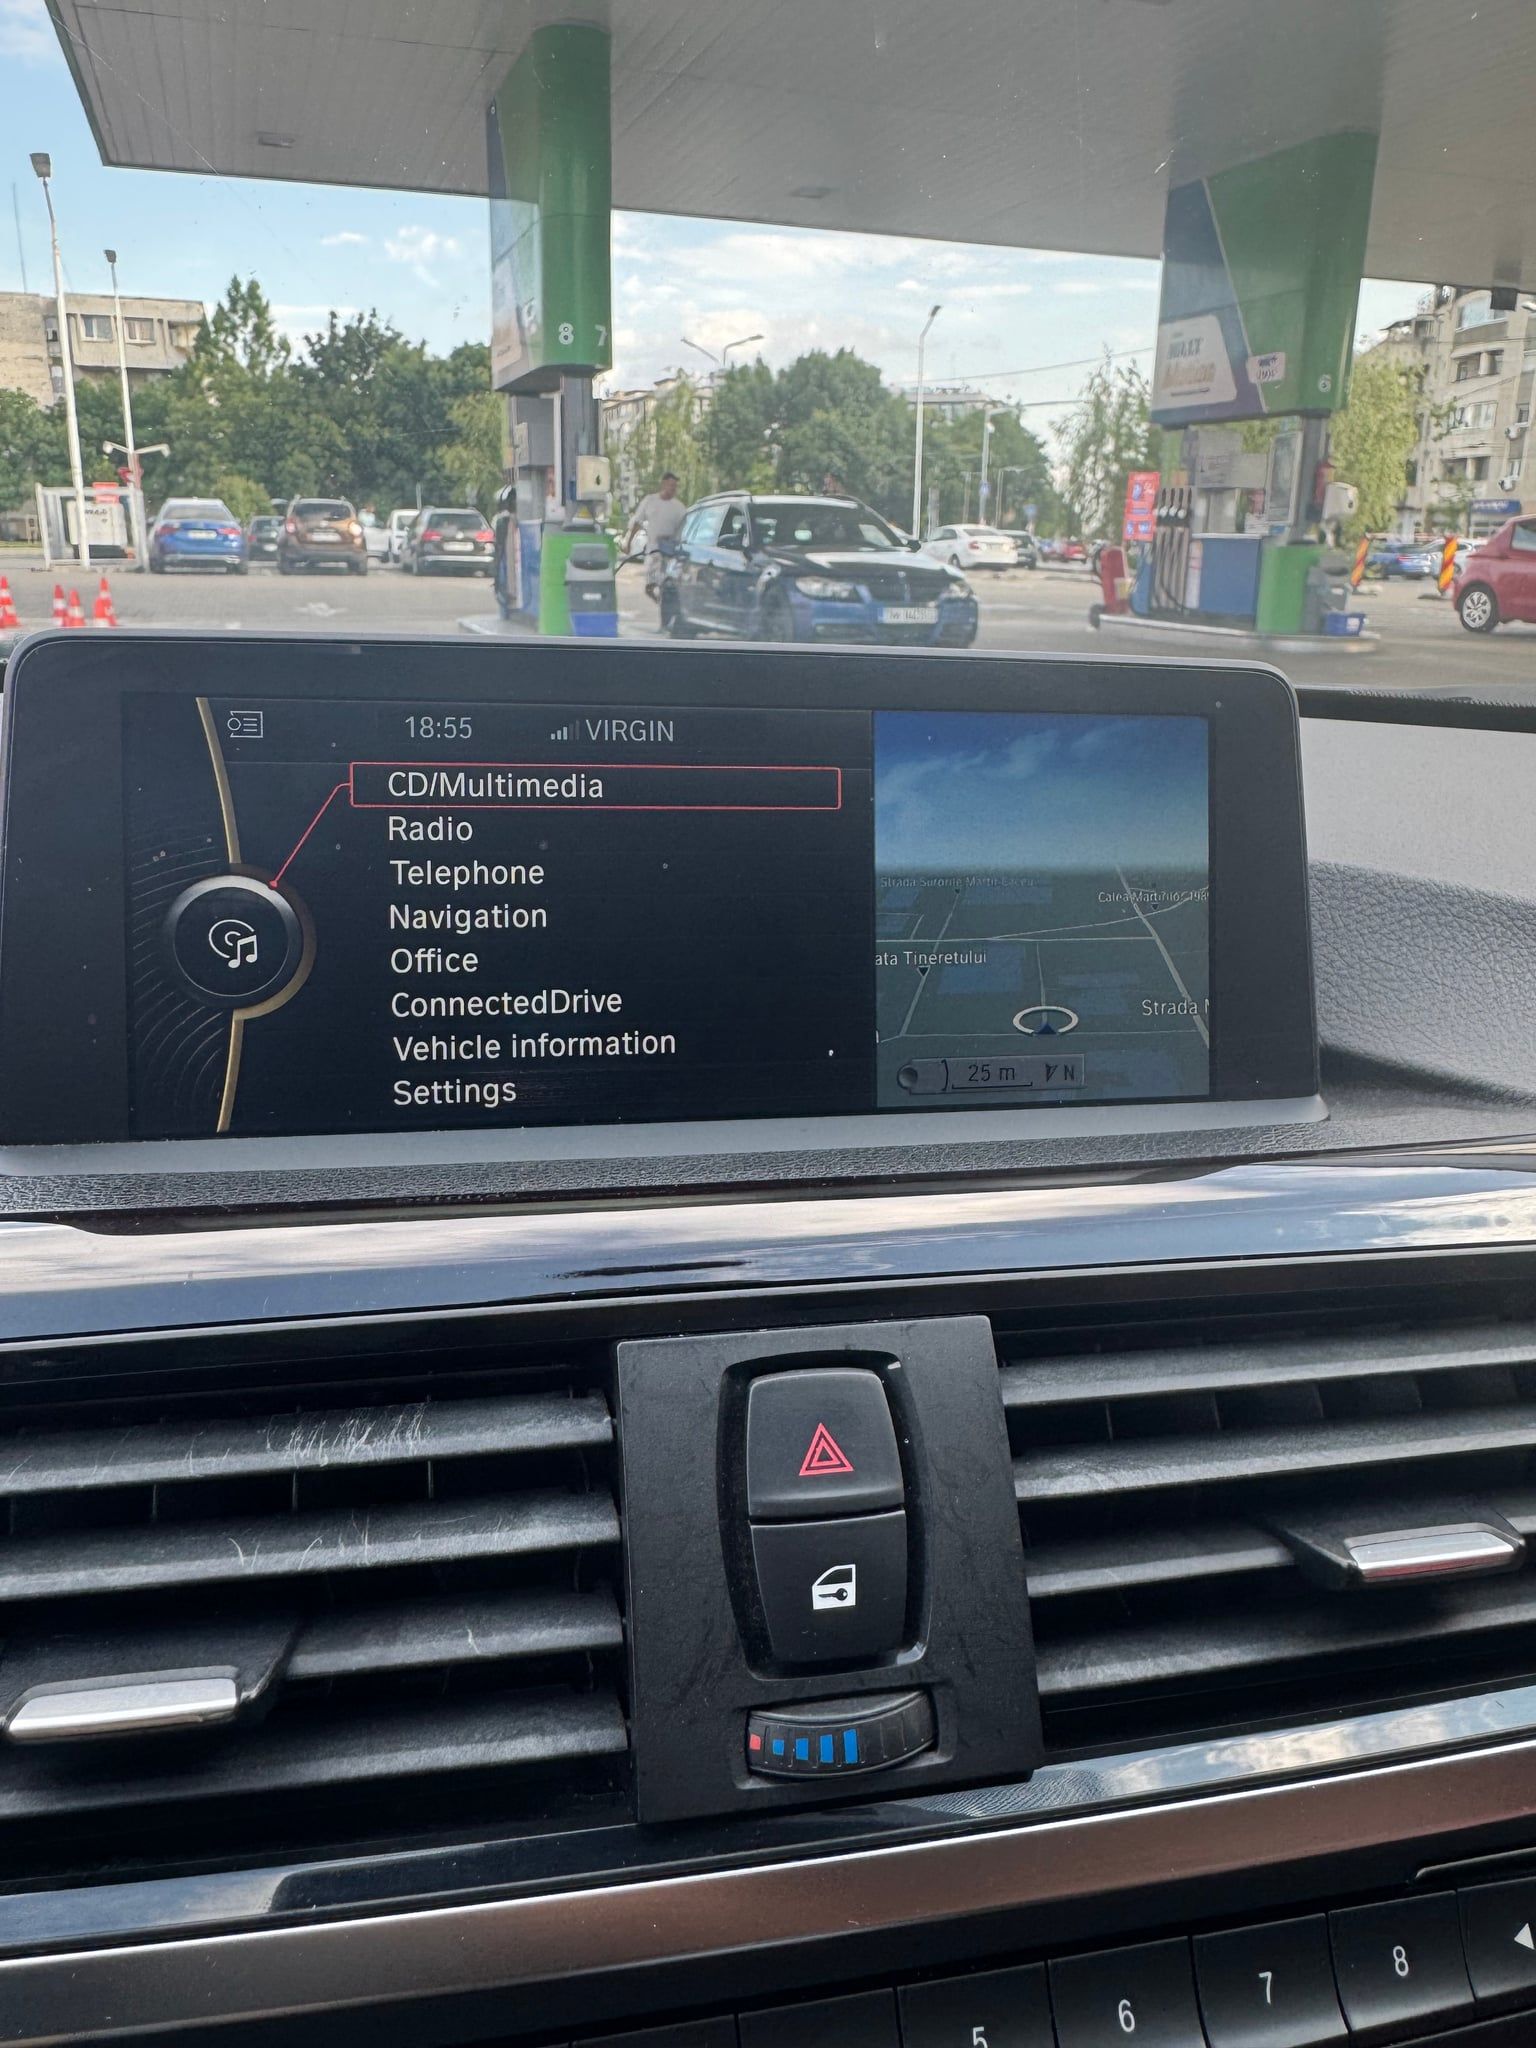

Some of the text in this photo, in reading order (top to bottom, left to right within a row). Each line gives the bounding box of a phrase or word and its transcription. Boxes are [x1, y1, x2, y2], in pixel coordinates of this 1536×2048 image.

[558, 322, 574, 345] 8
[594, 324, 608, 346] 7
[404, 716, 473, 739] 18:55
[586, 719, 674, 742] VIRGIN
[388, 772, 603, 798] CD/Multimedia
[388, 816, 473, 841] Radio
[389, 860, 544, 891] Telephone
[1098, 891, 1130, 903] Calea
[390, 904, 547, 934] Navigation
[391, 948, 479, 973] Office
[903, 951, 987, 966] Tineretului
[391, 989, 622, 1017] ConnectedDrive
[1142, 999, 1198, 1016] Strada
[393, 1030, 676, 1061] Vehicle information
[968, 1064, 1015, 1082] 25 m
[1064, 1064, 1075, 1081] N
[393, 1078, 517, 1108] Settings
[1392, 1945, 1409, 1977] 8
[1258, 1971, 1273, 2005] 7
[1118, 1999, 1135, 2032] 6
[972, 2026, 989, 2048] 5
